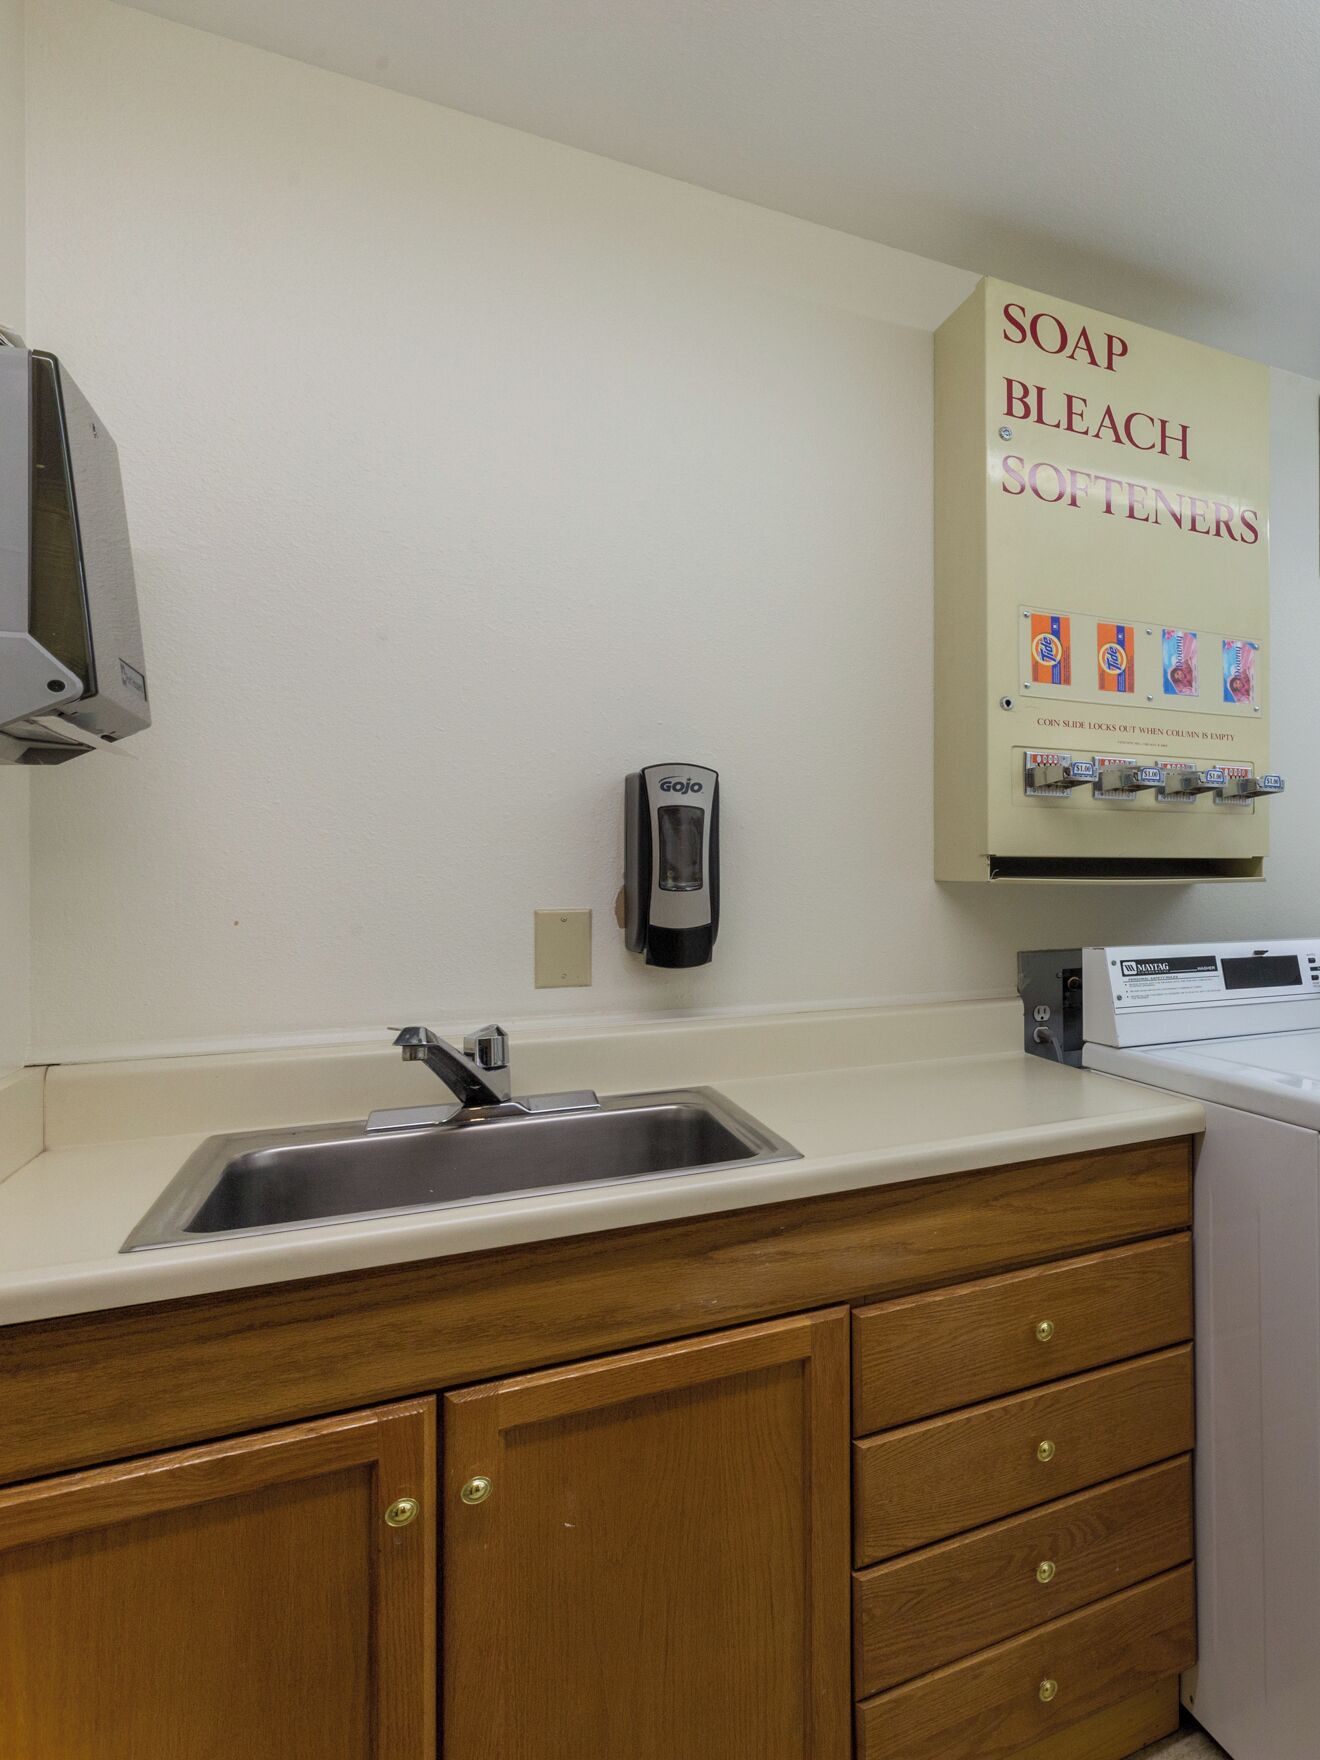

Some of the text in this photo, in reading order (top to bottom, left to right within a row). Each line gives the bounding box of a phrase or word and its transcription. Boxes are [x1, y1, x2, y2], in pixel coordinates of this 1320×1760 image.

[1003, 303, 1128, 372] SOAP
[1002, 376, 1190, 461] BLEACH
[1002, 455, 1259, 544] SOFTENERS
[1039, 636, 1057, 663] Tide
[1105, 645, 1122, 671] Tide
[1037, 717, 1061, 727] COIN
[1062, 719, 1086, 729] SLIDE
[1088, 722, 1117, 732] LOCKS
[1118, 725, 1137, 734] OUT
[1139, 727, 1164, 736] WHEN
[1166, 728, 1200, 739] COLUMN
[1210, 733, 1235, 742] EMPTY
[1075, 763, 1091, 774] $1.00
[1144, 769, 1159, 778] $1.00
[1208, 771, 1221, 780] $1.00
[1266, 777, 1279, 785] $1.00
[1137, 963, 1169, 972] MAYTAG
